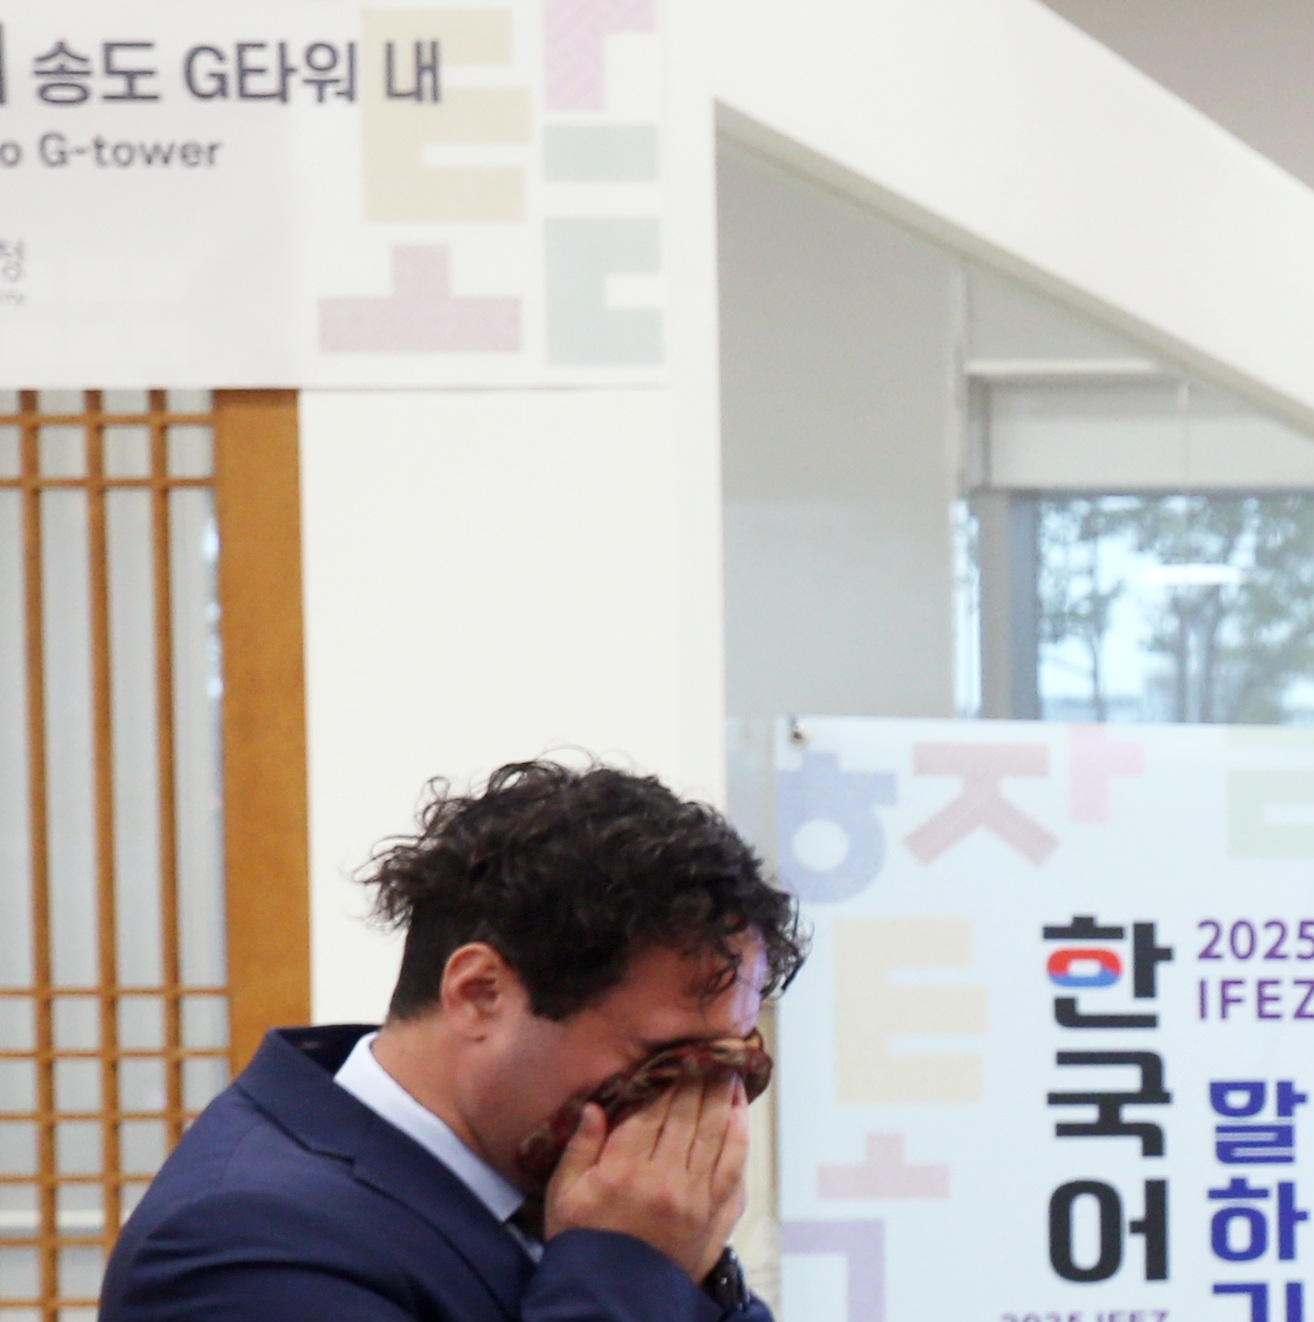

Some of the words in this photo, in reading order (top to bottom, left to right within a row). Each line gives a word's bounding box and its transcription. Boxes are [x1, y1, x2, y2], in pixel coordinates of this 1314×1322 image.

[32, 41, 161, 107] 송도
[182, 41, 357, 105] G타워
[384, 40, 441, 104] 내
[37, 131, 221, 168] G-tower
[1042, 915, 1174, 1284] 한국어
